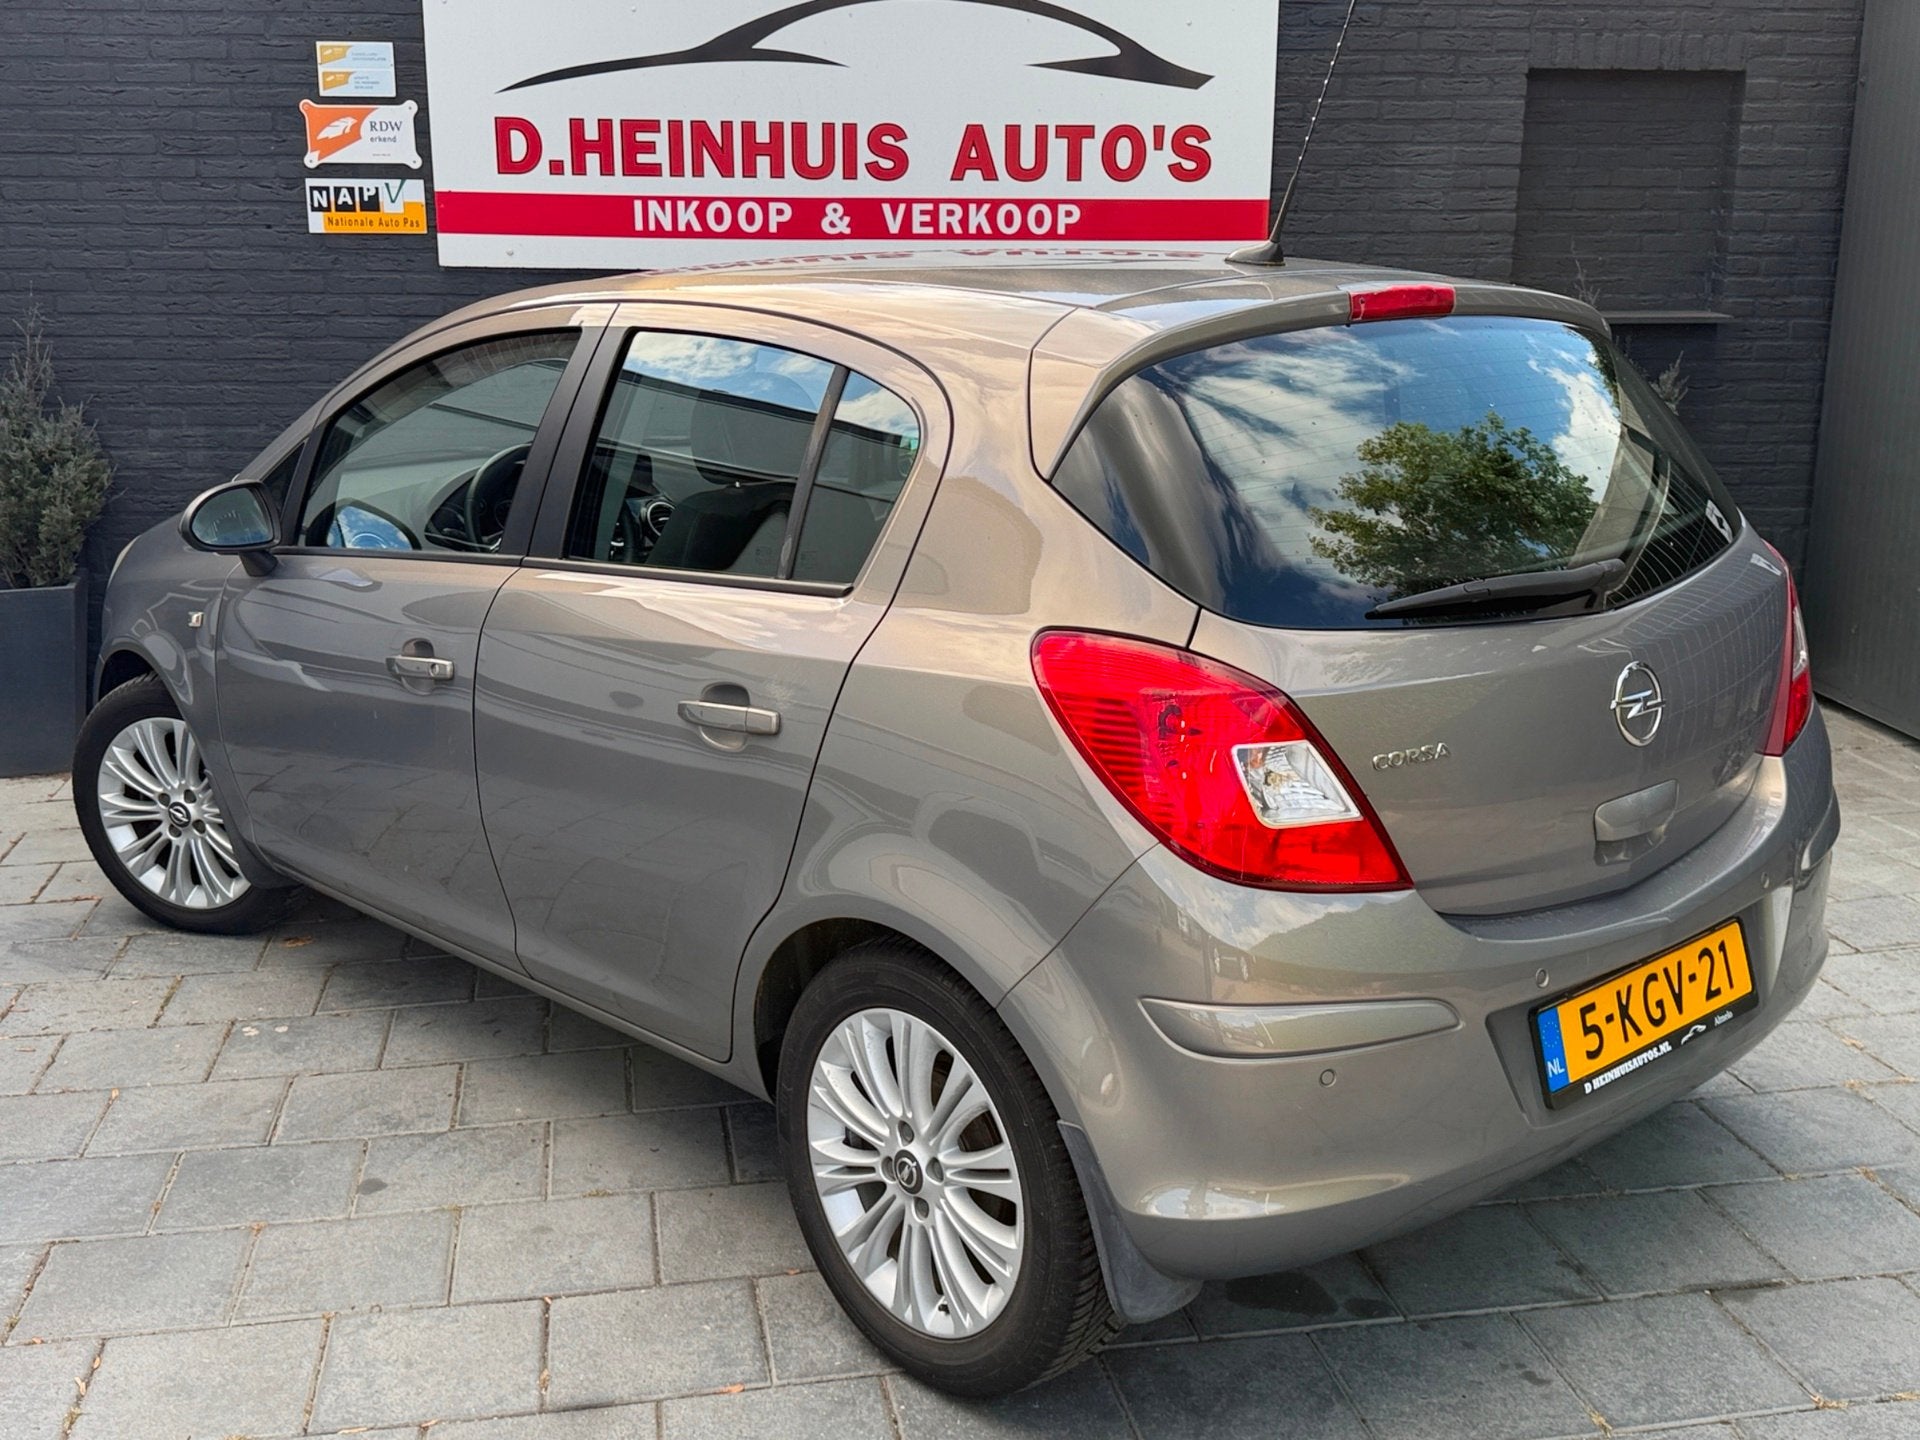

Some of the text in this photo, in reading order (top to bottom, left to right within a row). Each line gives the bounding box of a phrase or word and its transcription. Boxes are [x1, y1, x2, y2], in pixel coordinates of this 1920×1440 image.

[369, 121, 403, 132] RDW
[494, 116, 1213, 182] D.HEINHUIS AUTO'S
[327, 217, 420, 228] Nationale Auto Pas
[633, 199, 1082, 236] INKOOP & VERKOOP
[1372, 742, 1450, 770] CORSA
[1579, 940, 1735, 1060] 5-KGV-21
[1547, 1058, 1566, 1078] NL
